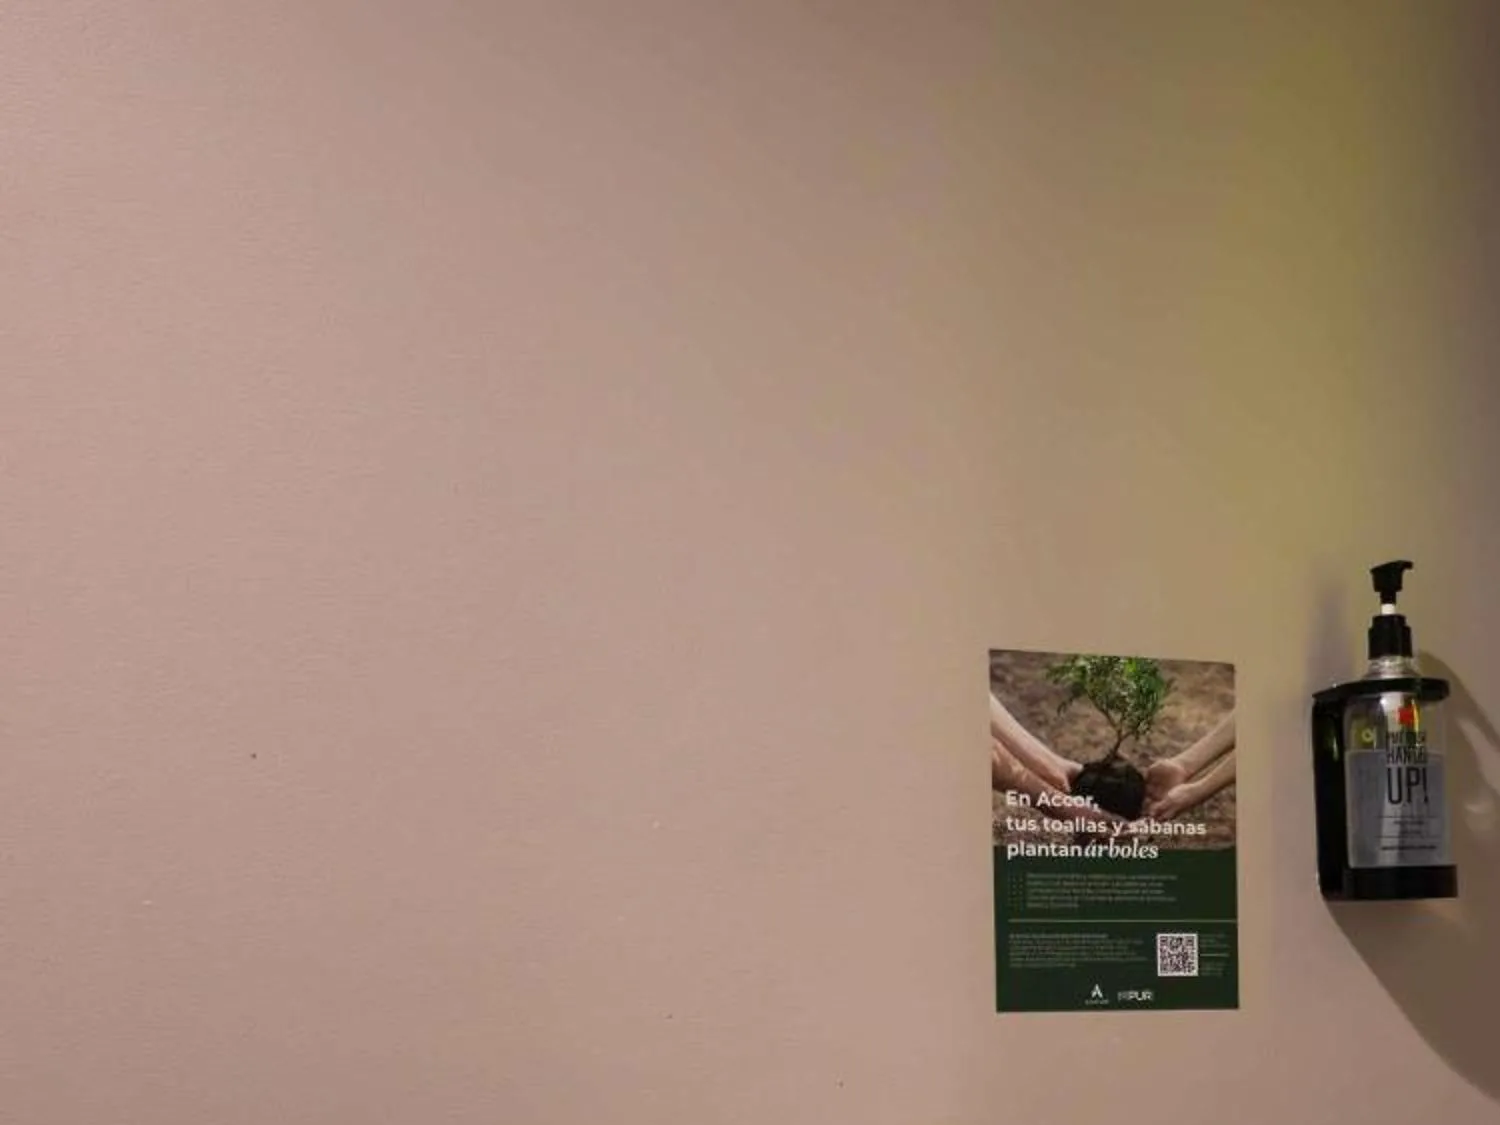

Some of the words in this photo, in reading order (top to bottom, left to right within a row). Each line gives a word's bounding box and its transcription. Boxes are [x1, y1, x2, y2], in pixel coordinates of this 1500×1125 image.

[1387, 767, 1429, 805] UP!
[1006, 790, 1031, 807] En
[1036, 791, 1099, 811] Accor,
[1006, 816, 1037, 832] tus
[1043, 816, 1107, 833] toallas
[1112, 822, 1125, 837] y
[1128, 818, 1207, 836] sábanas
[1007, 841, 1082, 861] plantan
[1084, 839, 1159, 860] árboles
